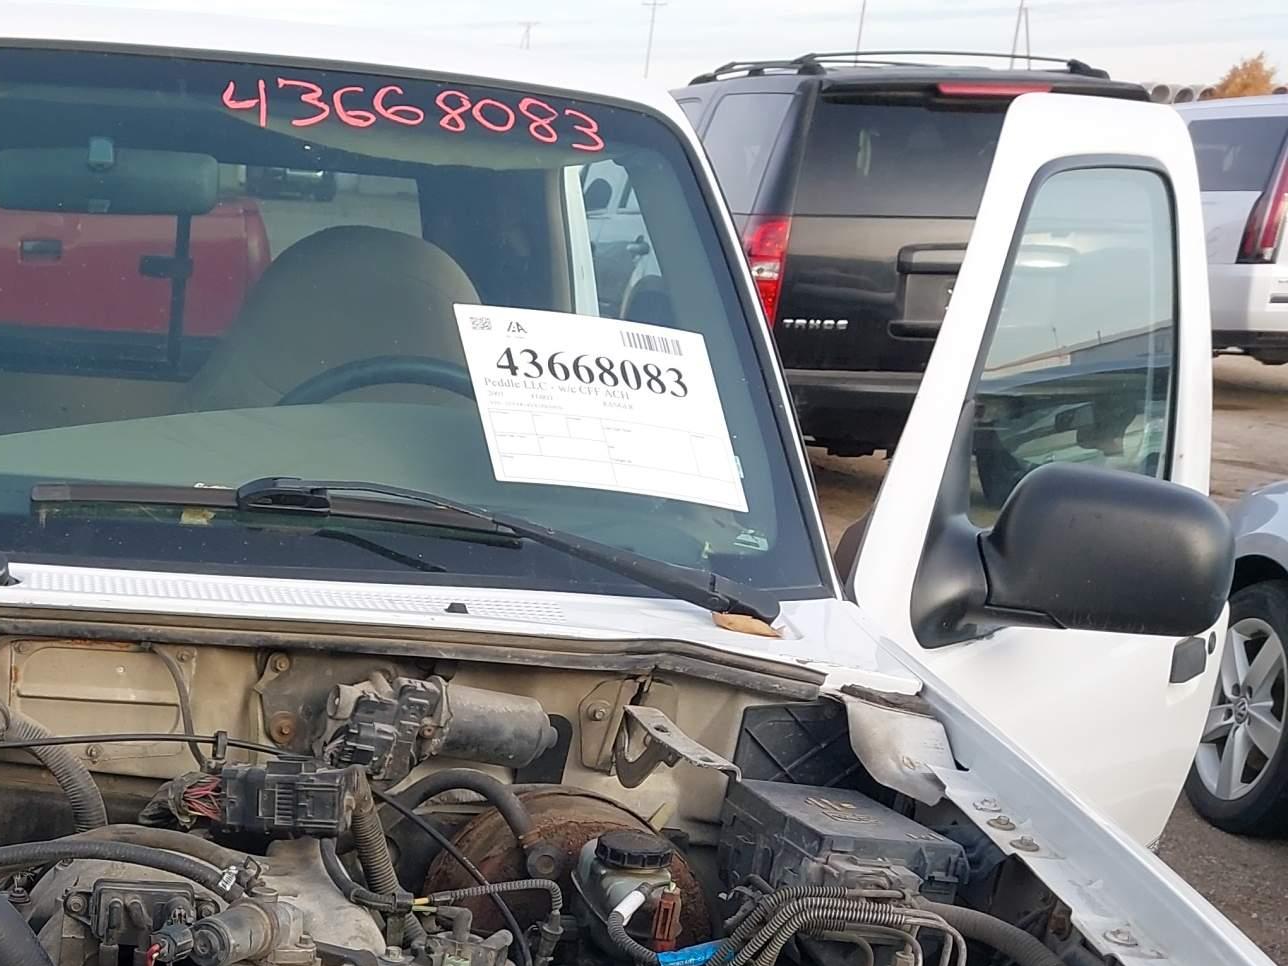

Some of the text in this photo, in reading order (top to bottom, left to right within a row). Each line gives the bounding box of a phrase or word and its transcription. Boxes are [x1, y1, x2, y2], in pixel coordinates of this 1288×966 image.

[222, 78, 604, 152] 43668083
[484, 377, 520, 389] Peddle
[523, 380, 547, 390] LLC
[496, 347, 688, 398] 43668083
